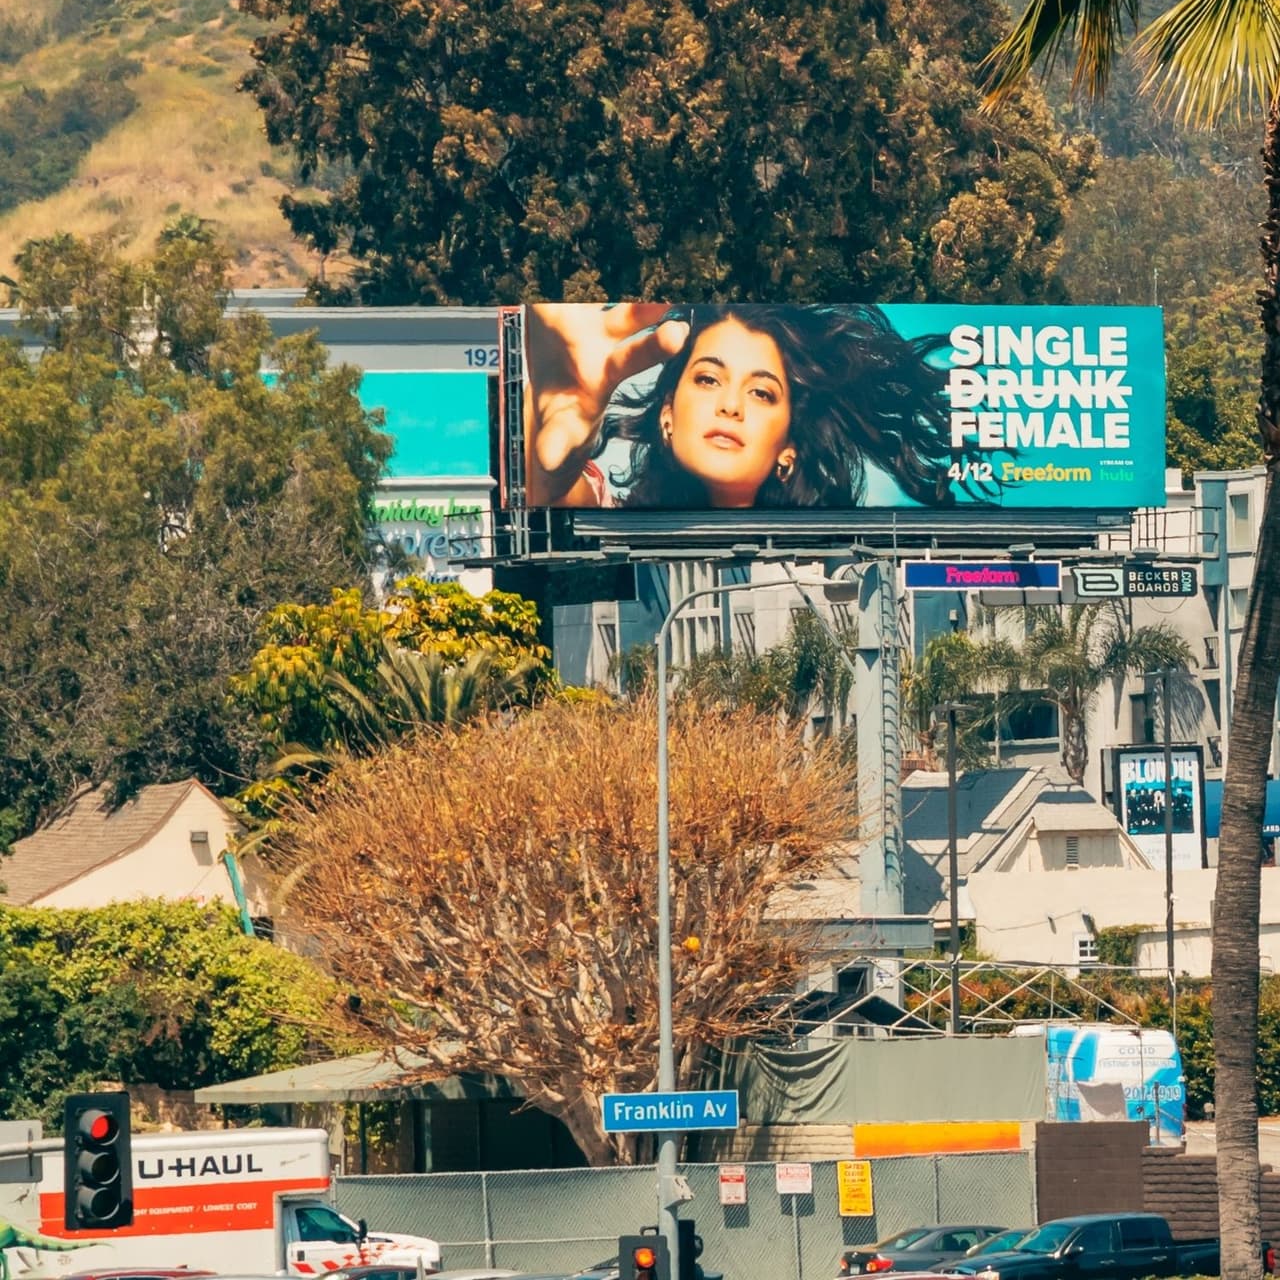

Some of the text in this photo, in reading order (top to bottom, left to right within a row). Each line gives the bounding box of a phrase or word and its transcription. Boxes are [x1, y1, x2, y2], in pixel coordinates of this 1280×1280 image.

[949, 325, 1127, 368] SINGLE
[947, 368, 1131, 409] DRUNK
[950, 411, 1130, 449] FEMALE
[947, 461, 1091, 482] 4/12 Freeform
[1100, 469, 1134, 481] hulu
[1128, 571, 1179, 582] BECKER
[1128, 582, 1179, 593] BOARDS
[613, 1099, 727, 1121] Franklin Av
[138, 1153, 263, 1179] U-HAUL
